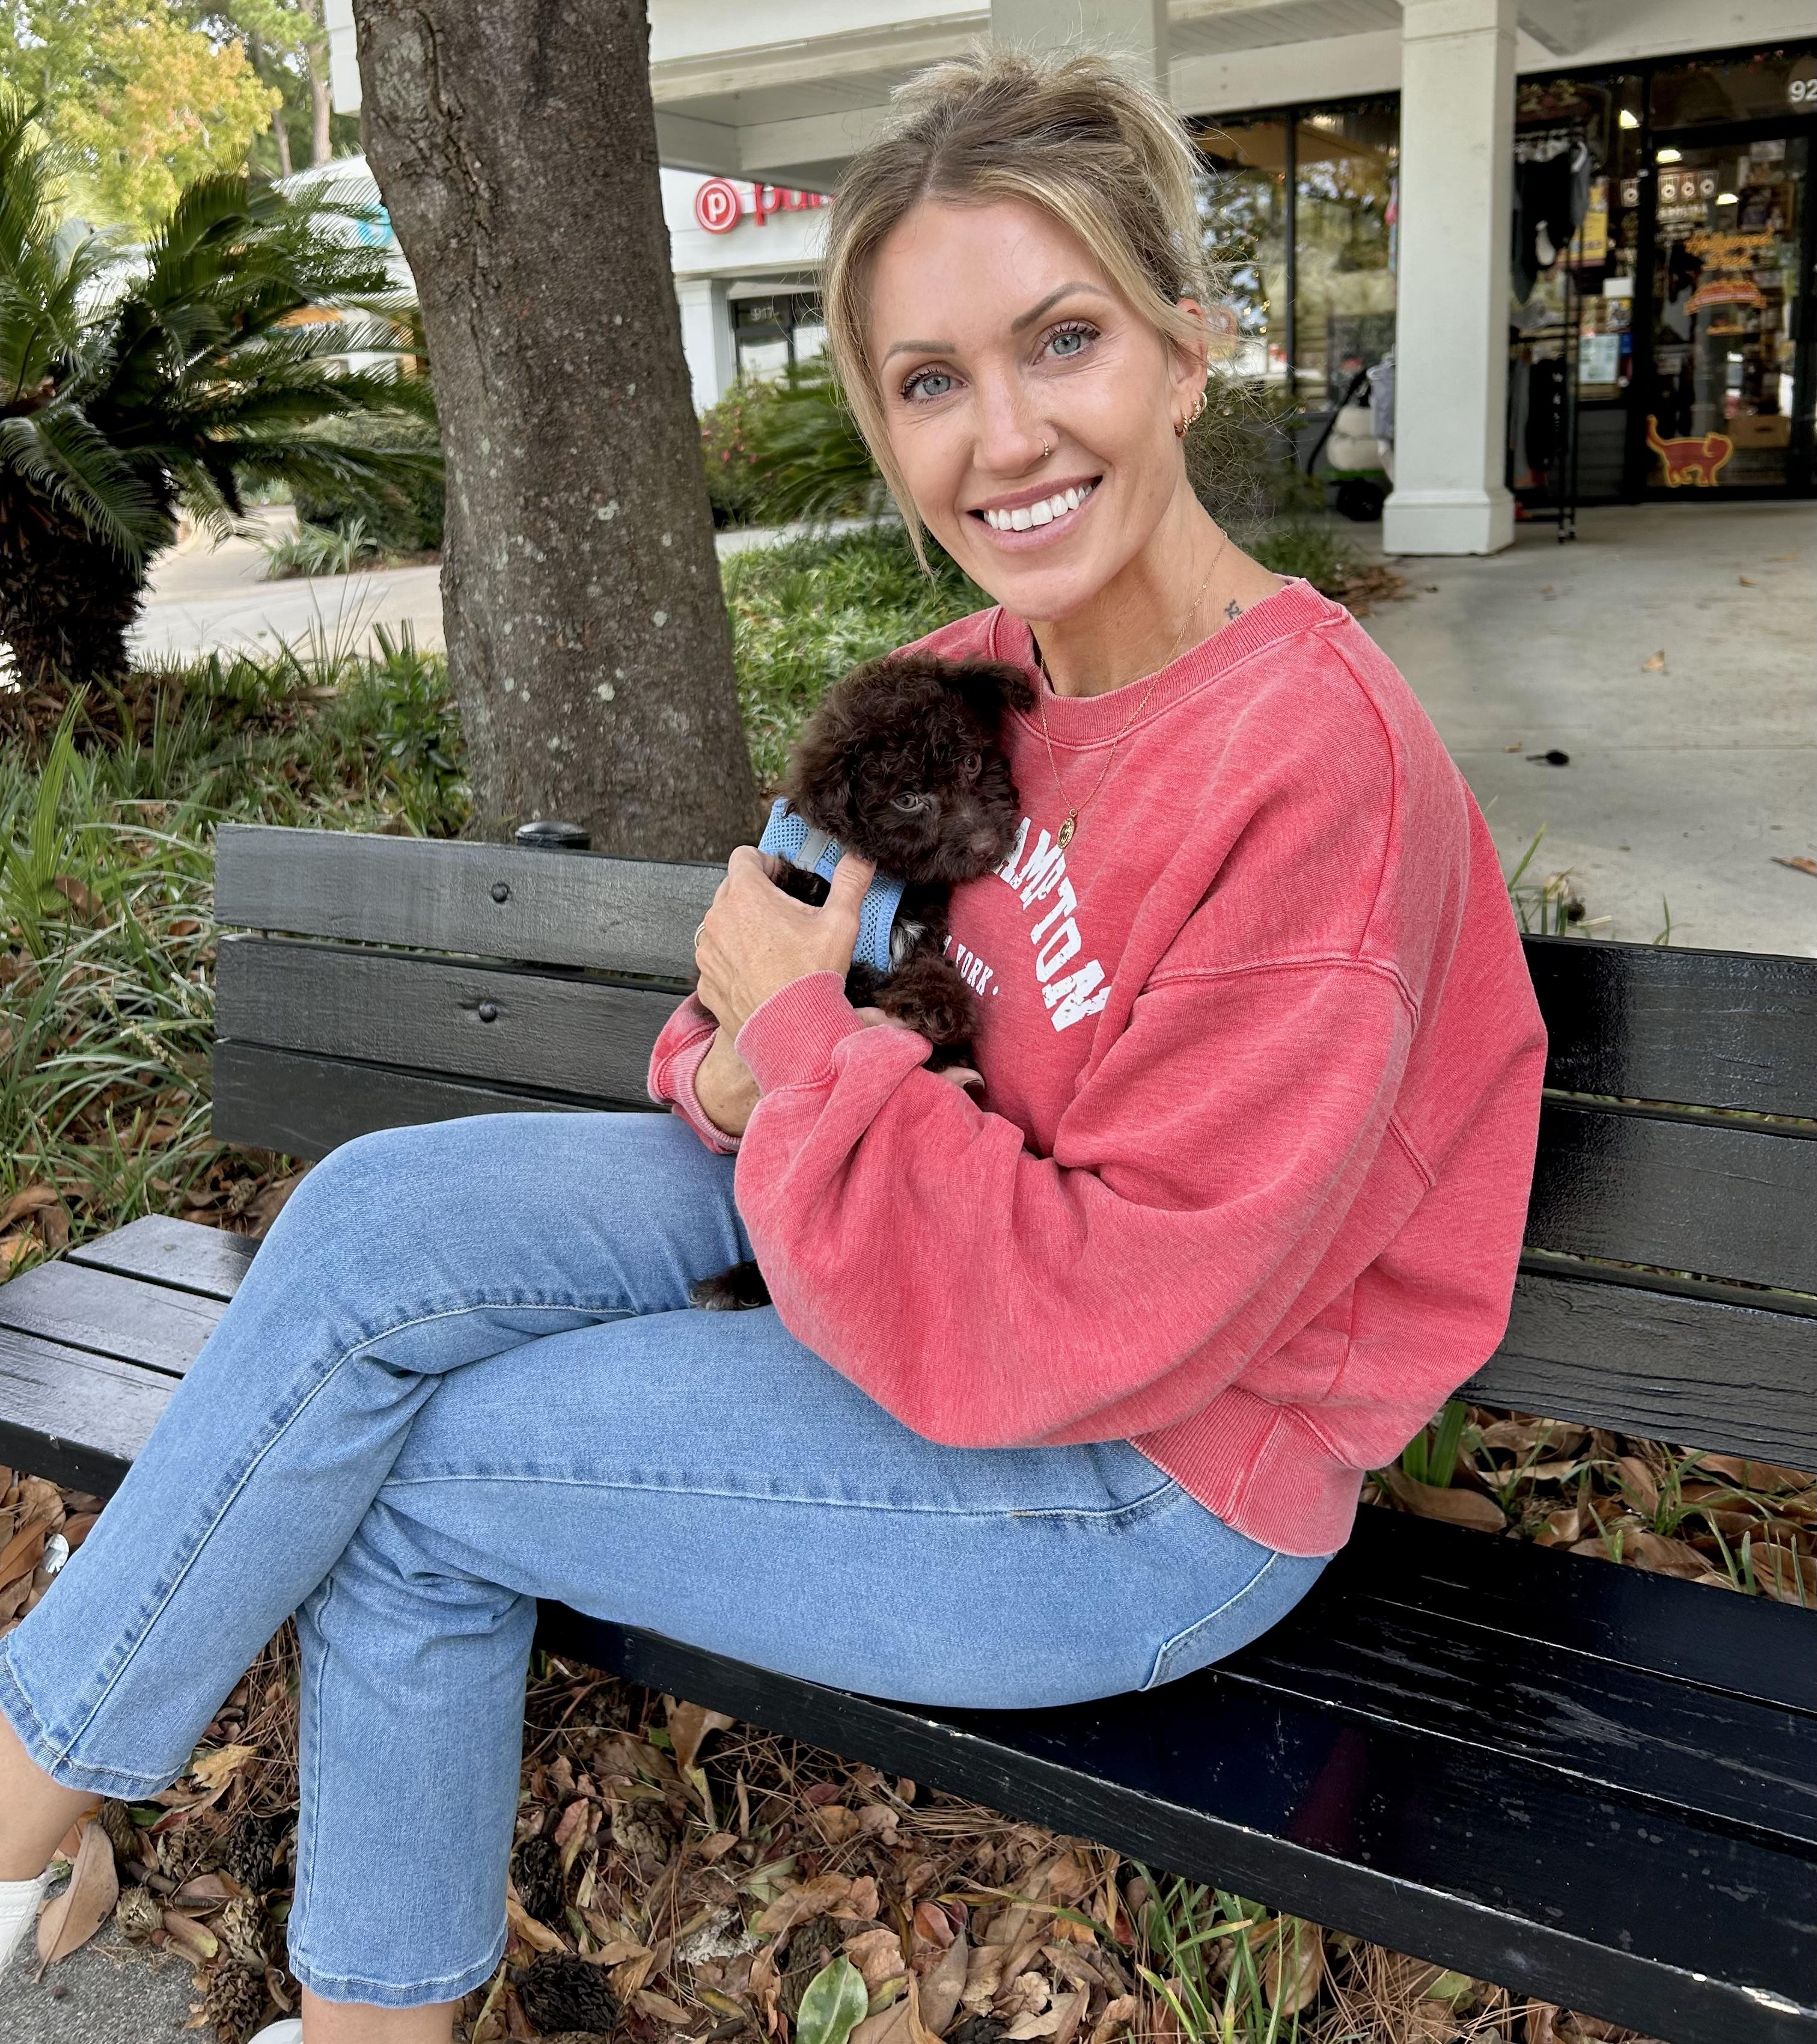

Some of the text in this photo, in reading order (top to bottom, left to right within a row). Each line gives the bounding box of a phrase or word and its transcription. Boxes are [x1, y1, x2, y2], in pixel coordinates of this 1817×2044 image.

[1790, 78, 1817, 103] 92
[755, 183, 837, 226] pu
[993, 816, 1112, 1032] AMPTON
[956, 943, 993, 996] YORK
